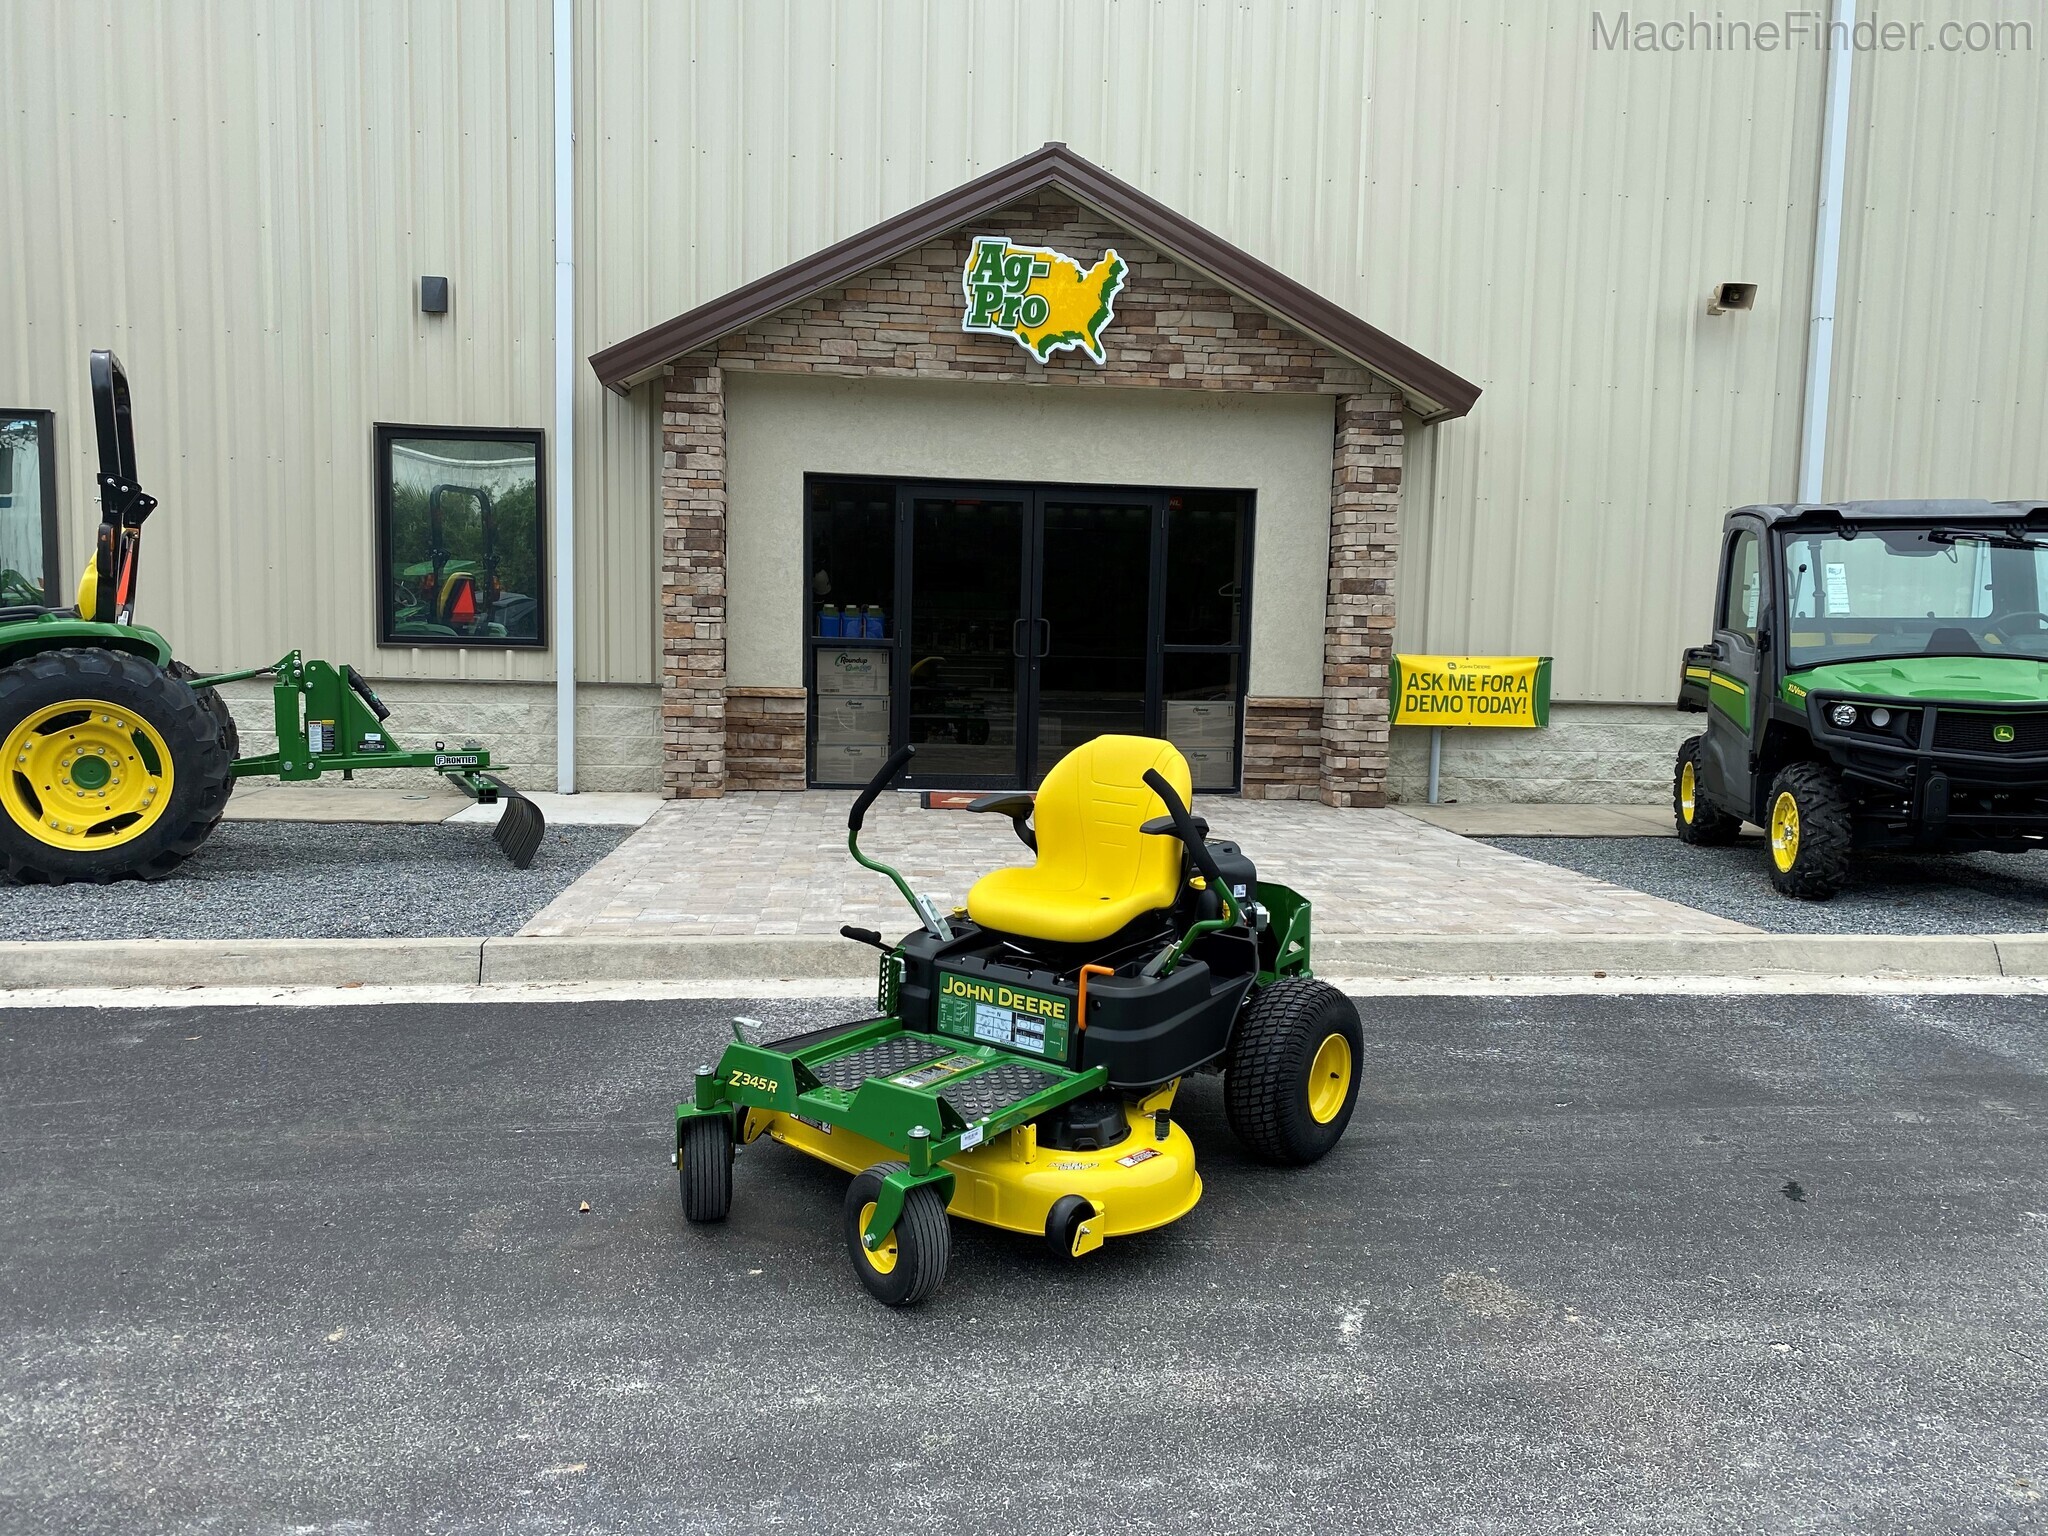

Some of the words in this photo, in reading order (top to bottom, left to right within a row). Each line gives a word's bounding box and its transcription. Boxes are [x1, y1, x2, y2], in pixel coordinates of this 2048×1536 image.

[969, 241, 1051, 293] Ag-
[967, 284, 1050, 328] Pro
[840, 657, 868, 665] Roundup
[1407, 673, 1444, 691] ASK
[1449, 674, 1476, 692] ME
[1481, 675, 1515, 693] FOR
[1517, 675, 1528, 693] A
[1405, 694, 1463, 713] DEMO
[1467, 695, 1527, 714] TODAY!
[436, 755, 477, 766] FRONTIER
[943, 977, 993, 1003] JOHN
[998, 988, 1065, 1019] DEERE
[729, 1070, 778, 1094] Z345R
